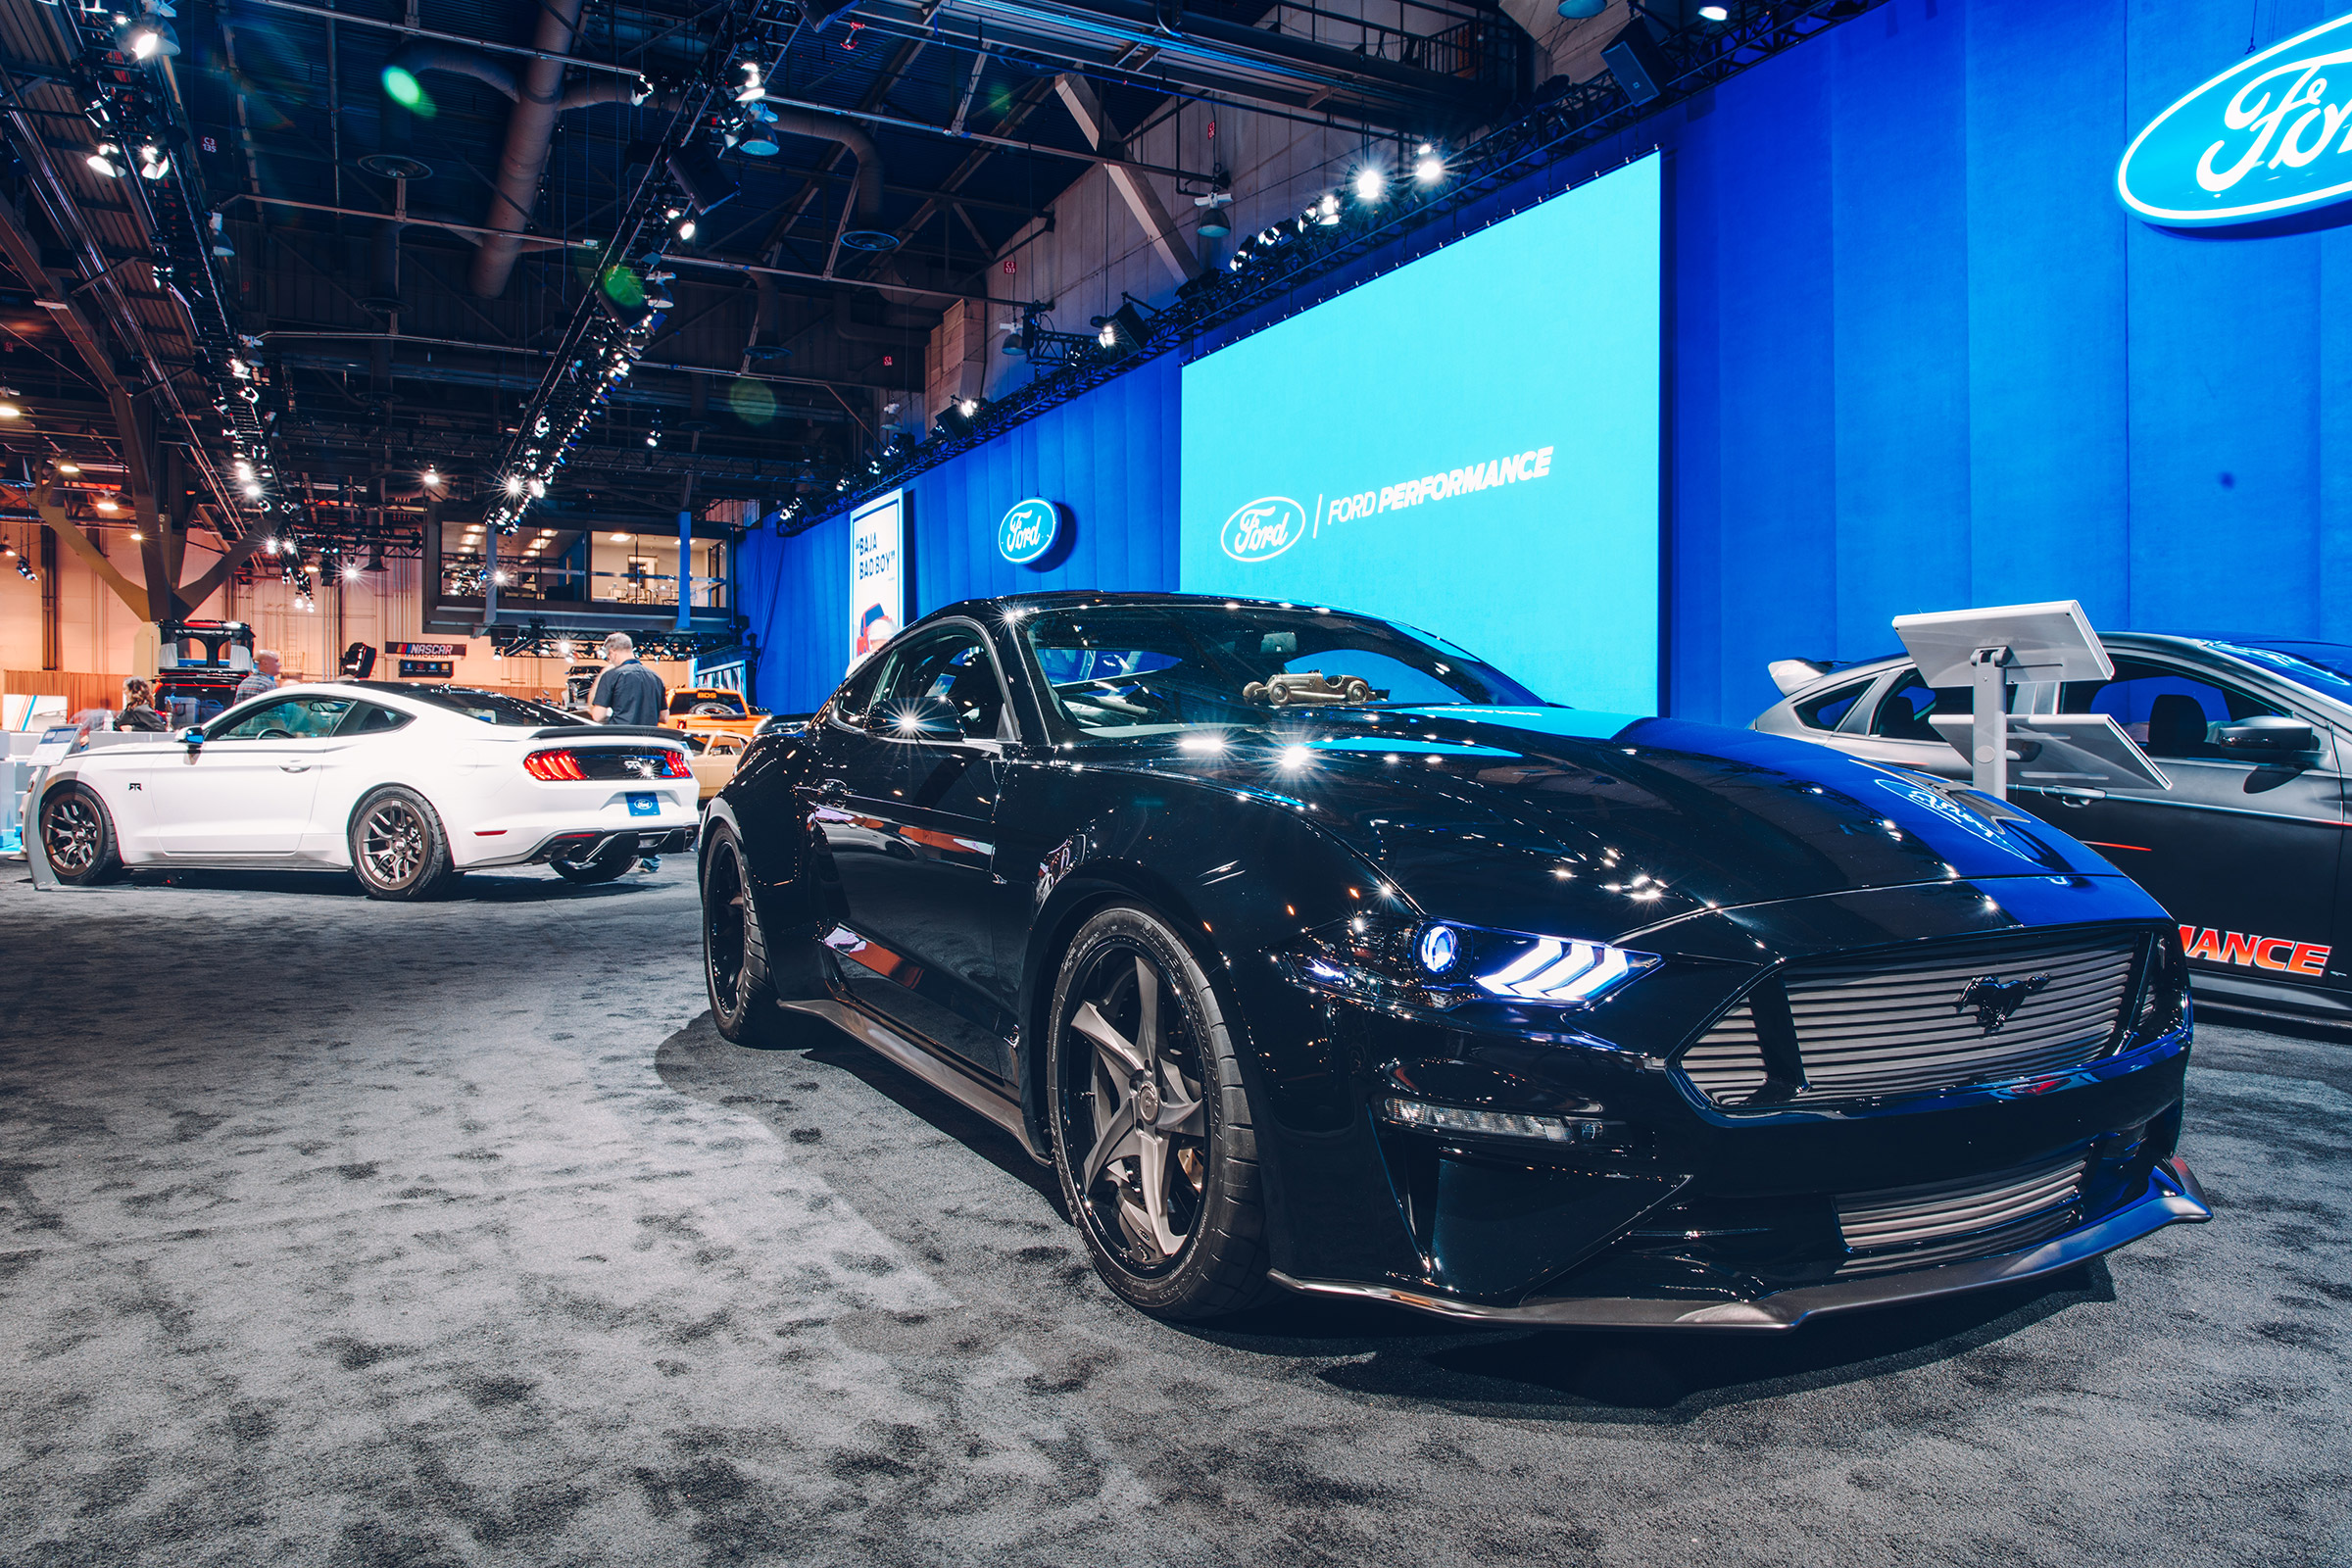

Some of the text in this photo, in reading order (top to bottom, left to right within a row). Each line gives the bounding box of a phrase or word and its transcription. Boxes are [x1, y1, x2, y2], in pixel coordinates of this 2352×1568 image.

[1327, 446, 1554, 525] FORD PERFORMANCE
[1006, 510, 1042, 552] Ford
[1234, 506, 1291, 554] Ford
[859, 558, 874, 580] BAD
[411, 644, 453, 655] NASCAR
